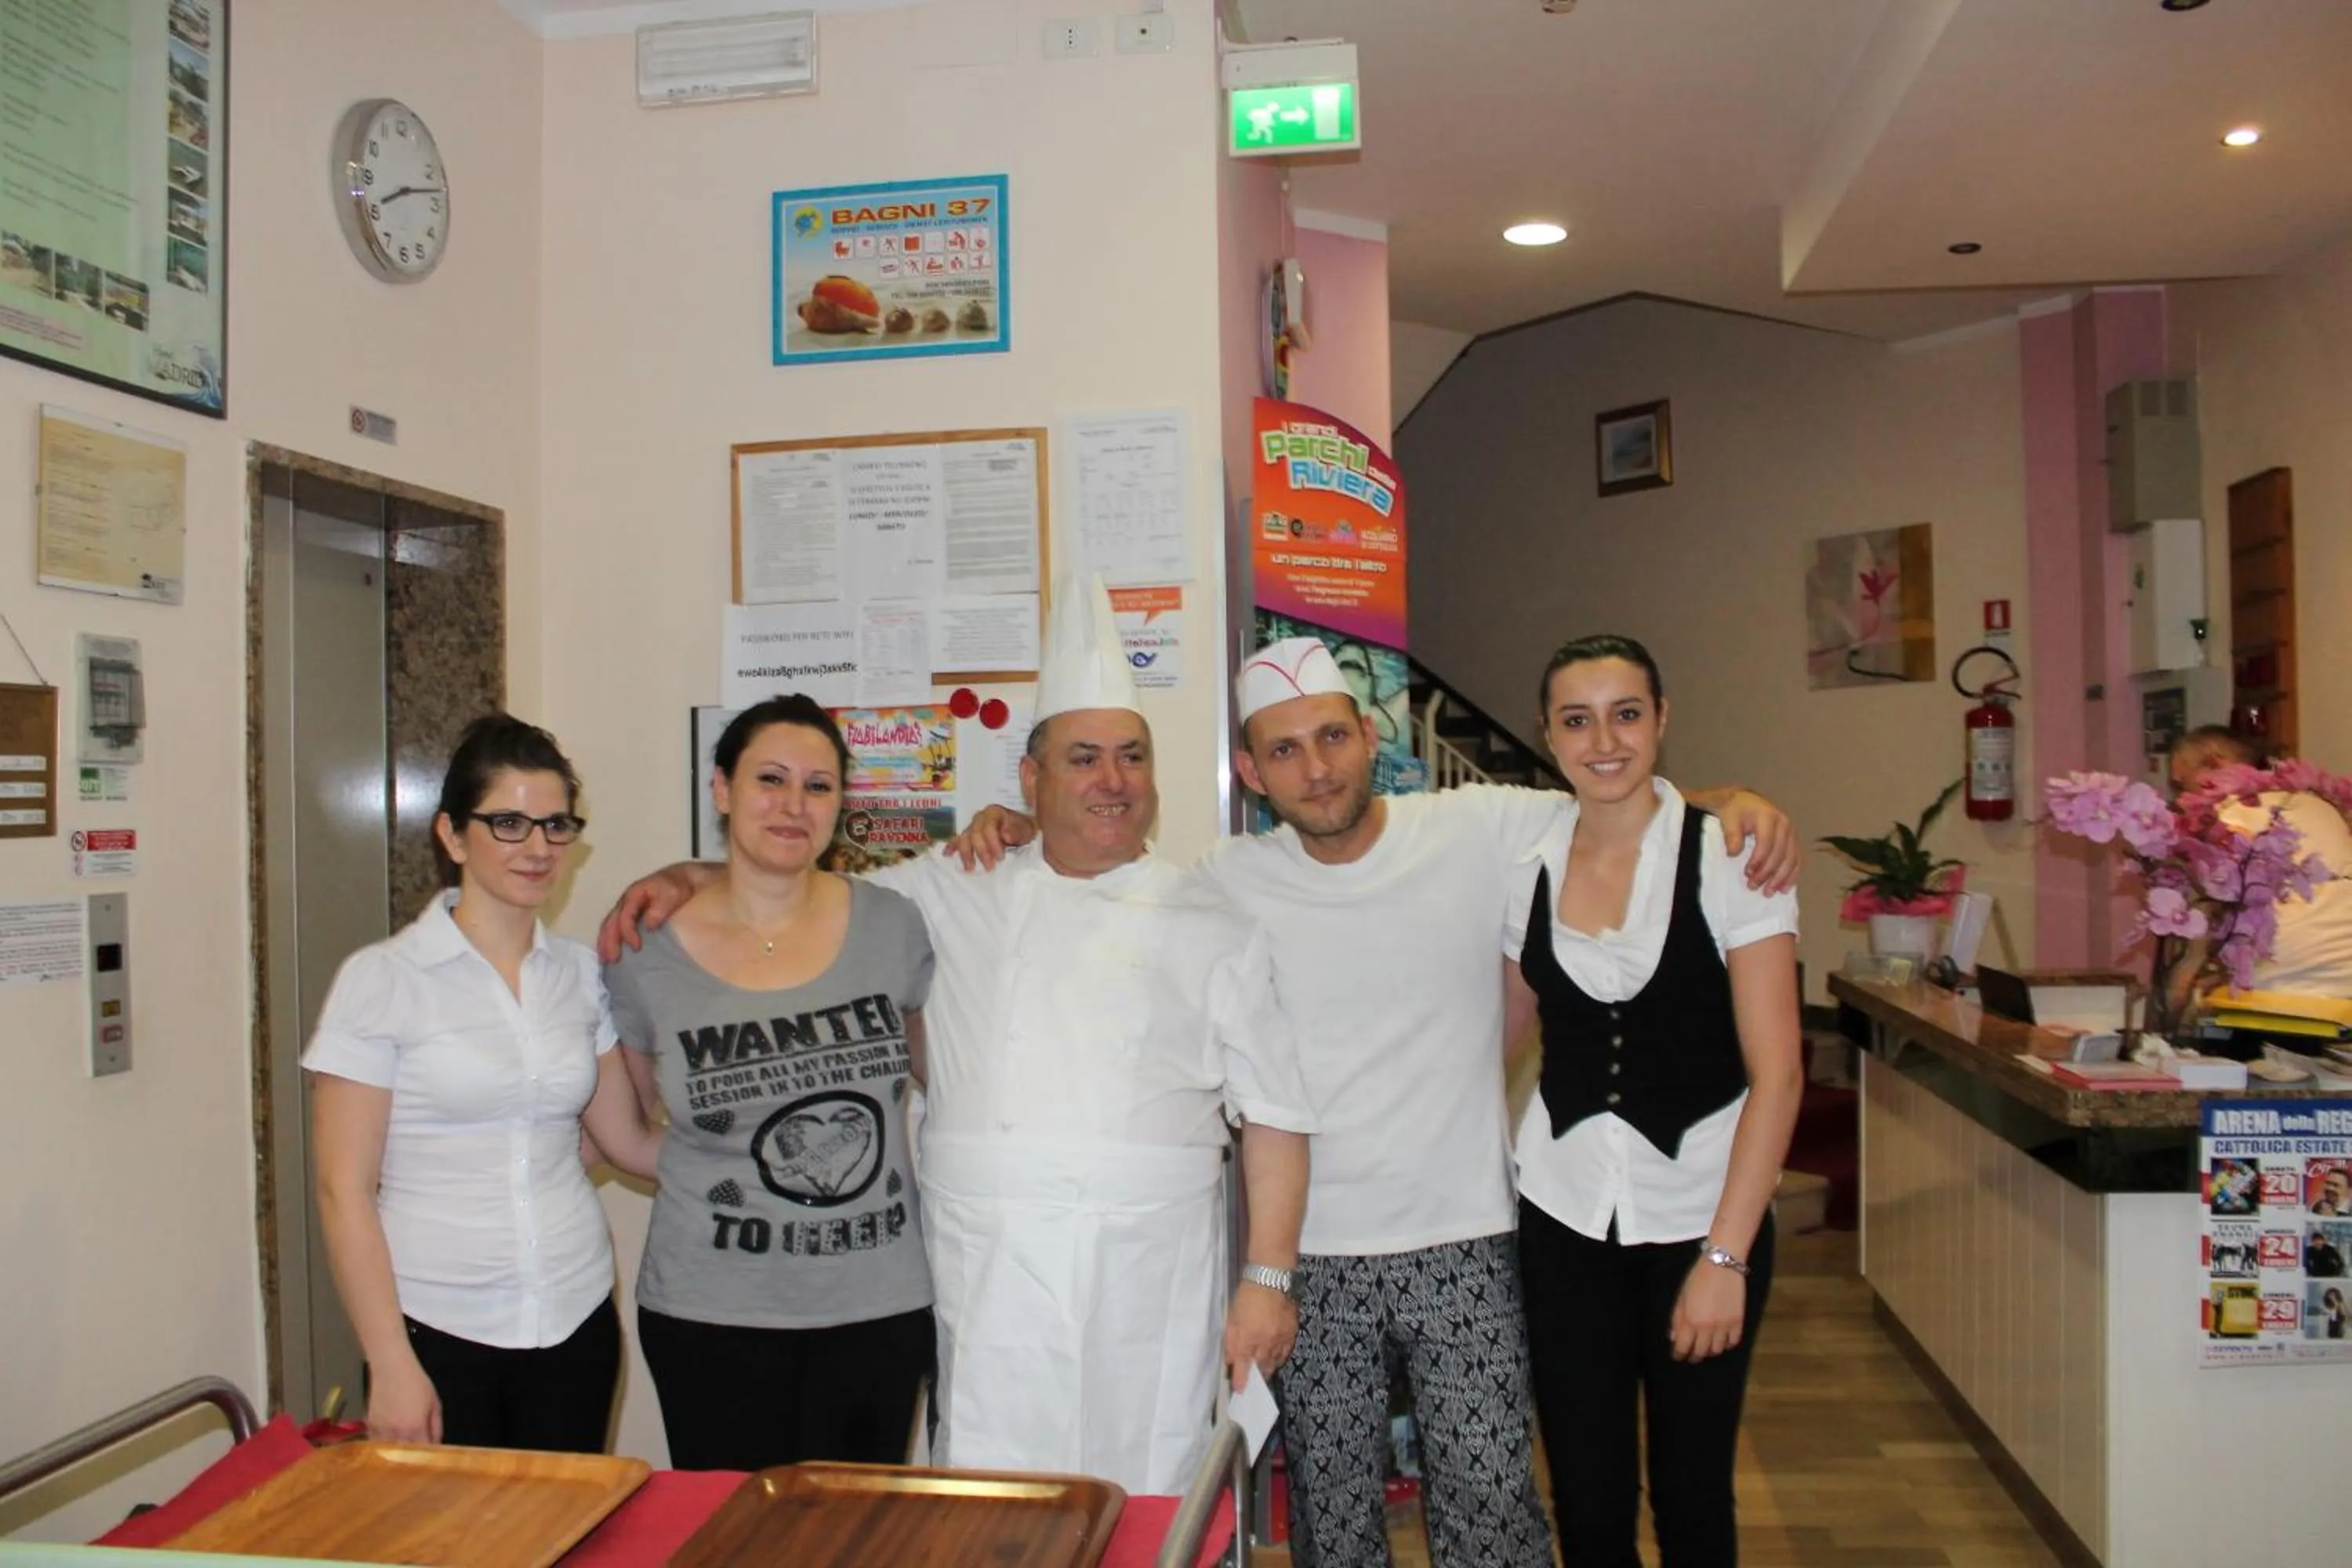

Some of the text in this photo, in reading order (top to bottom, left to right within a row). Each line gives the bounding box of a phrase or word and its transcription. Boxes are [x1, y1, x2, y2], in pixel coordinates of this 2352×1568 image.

[364, 169, 373, 186] 9
[831, 198, 991, 225] BAGNI 37
[873, 816, 925, 832] SAFARI
[867, 829, 930, 844] RAVENNA
[689, 1084, 764, 1110] SESSION
[2212, 1109, 2281, 1135] ARENA
[2214, 1138, 2347, 1155] CATTOLICA ESTATE
[2266, 1175, 2298, 1194] 20
[712, 1213, 771, 1254] TO
